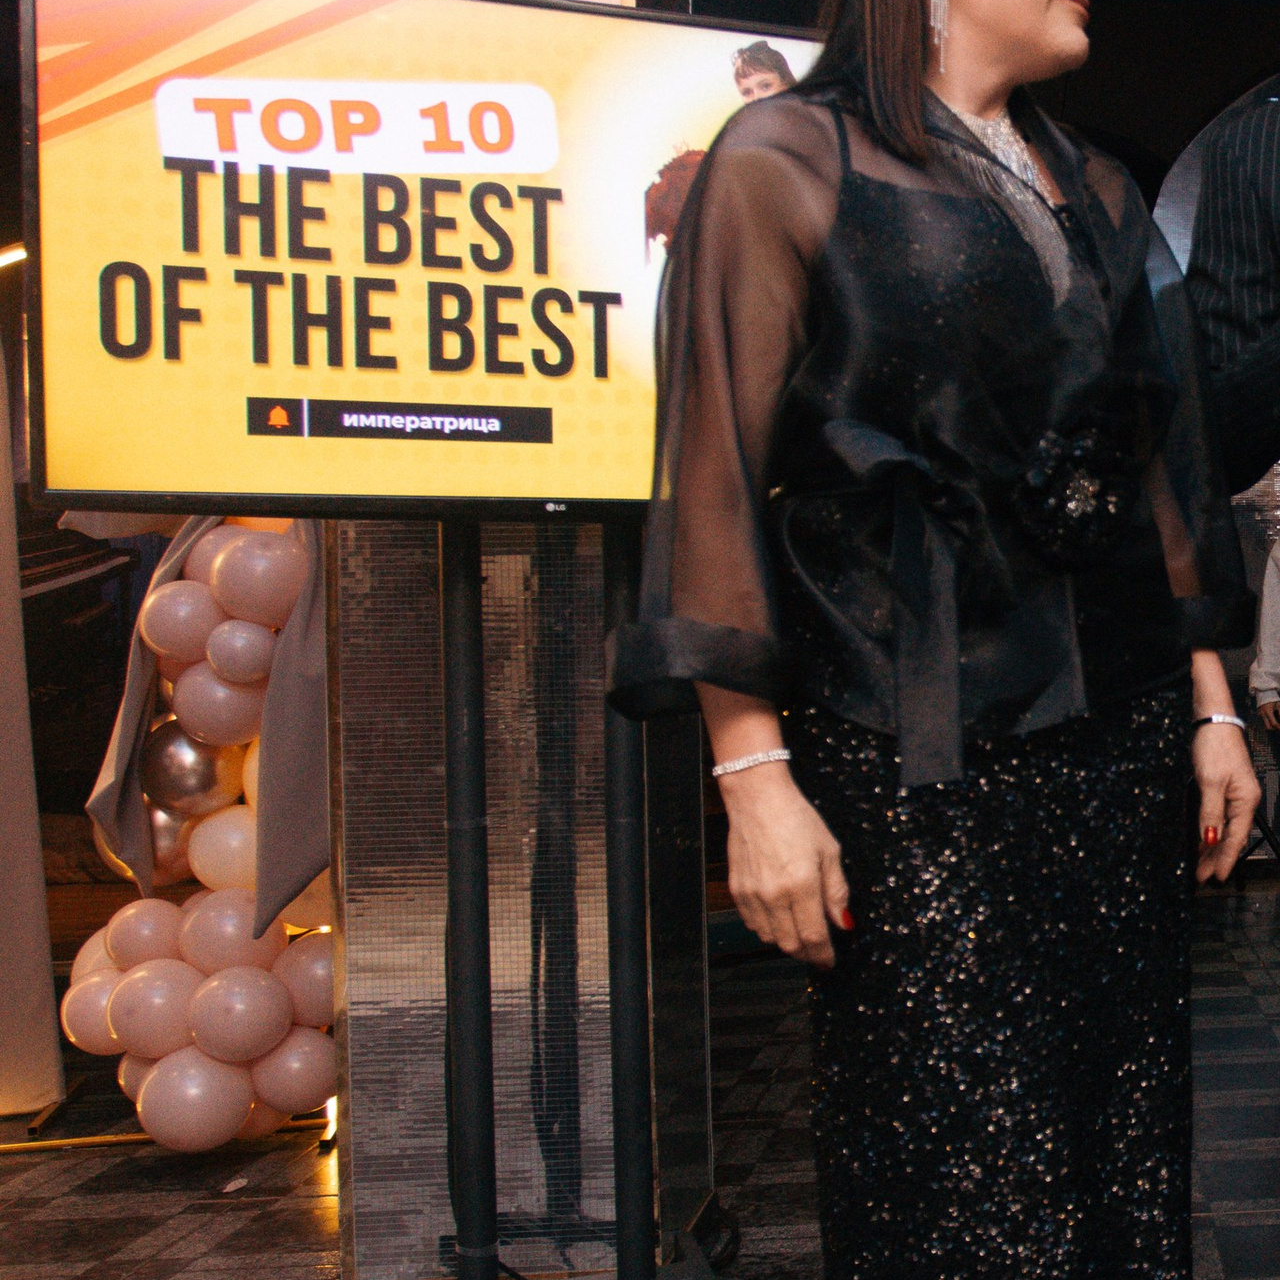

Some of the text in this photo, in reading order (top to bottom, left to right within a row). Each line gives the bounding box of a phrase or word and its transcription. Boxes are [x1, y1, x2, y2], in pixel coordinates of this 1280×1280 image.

[194, 97, 514, 153] TOP 10
[163, 157, 563, 275] THE BEST
[98, 261, 623, 380] OF THE BEST
[343, 413, 500, 433] императрица
